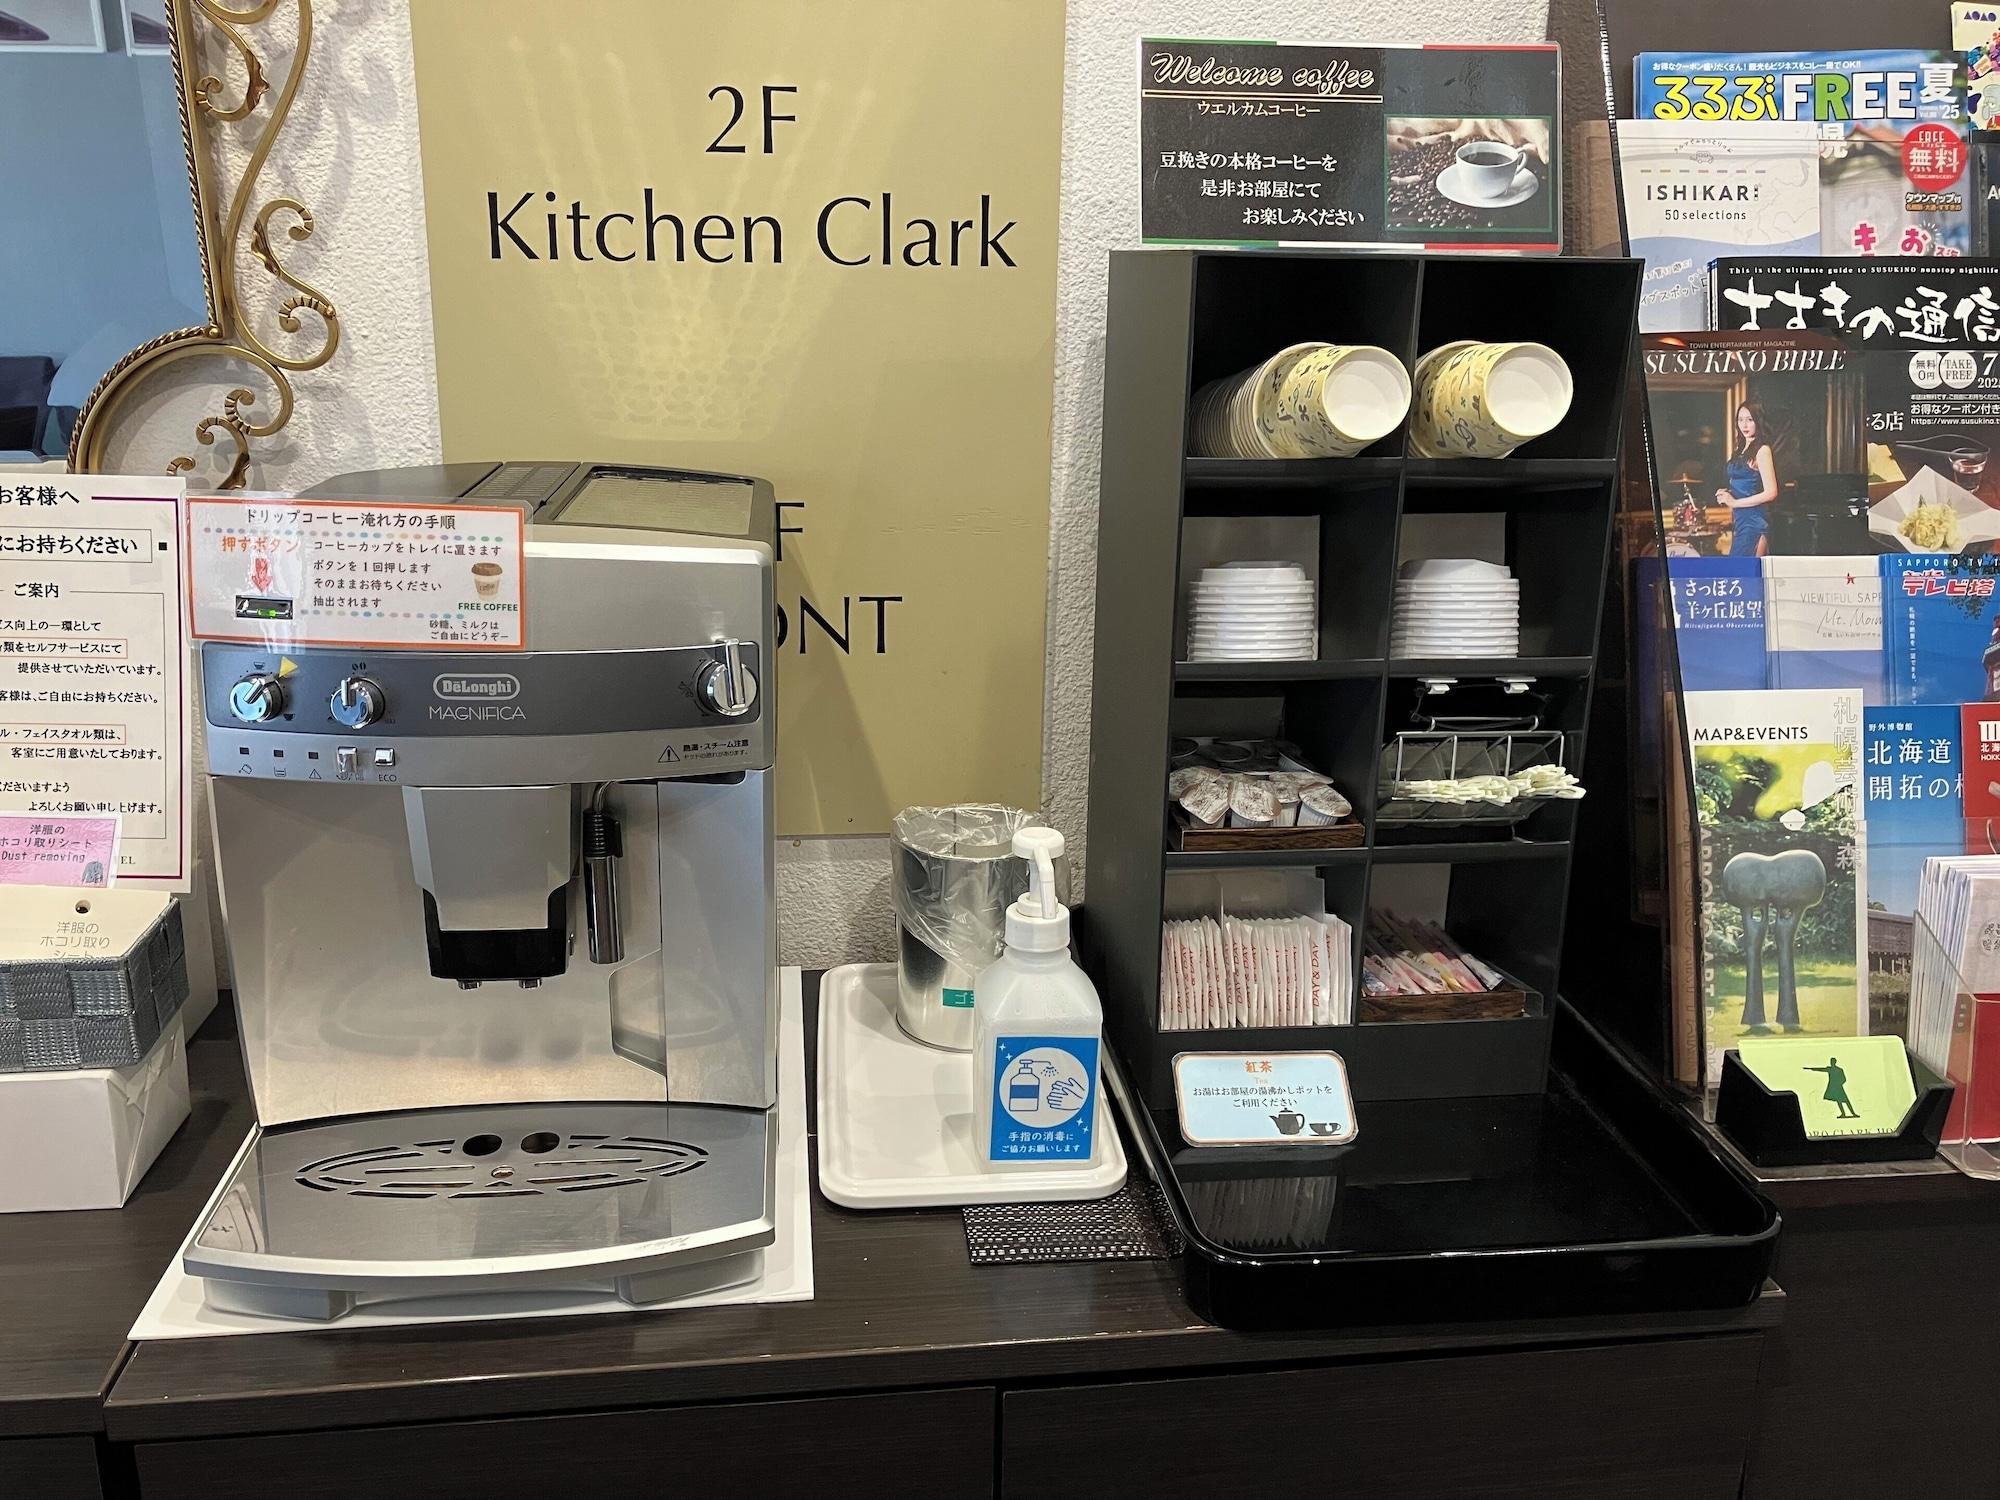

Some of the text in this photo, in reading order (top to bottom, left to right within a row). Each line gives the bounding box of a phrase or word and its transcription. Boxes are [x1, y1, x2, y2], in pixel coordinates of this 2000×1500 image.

[1151, 53, 1374, 95] Welcome coffee
[1919, 63, 1959, 103] 夏
[1197, 101, 1321, 117] ウエルカムコーヒー
[706, 86, 797, 153] 2F
[1160, 150, 1337, 172] 豆挽きの本格コーヒーを
[1909, 148, 1960, 173] 無料
[1200, 178, 1322, 199] 是非お部屋にて
[1242, 206, 1365, 227] お楽しみください
[1665, 209, 1747, 221] 50 selections
[487, 188, 1018, 267] Kitchen Clark
[1728, 266, 1999, 275] This is the ultimate guide to SUSUKINO nonstop nightlife
[1644, 349, 1847, 375] SUSUKINO BIBLE
[1945, 360, 1973, 370] TAKE
[1983, 353, 1999, 376] 7
[1945, 370, 1973, 380] FREE
[247, 508, 456, 530] ドリップコーヒー淹れ方の手順
[221, 536, 300, 553] 押すボタン
[313, 540, 502, 557] コーヒーカップをトレイに置きます
[1897, 558, 1959, 566] SAPPORO
[1969, 558, 1984, 566] TV
[14, 583, 60, 599] ご案内
[313, 578, 442, 592] そのままお待ちください
[1685, 579, 1743, 597] さっぽろ
[1903, 578, 1995, 597] テレビ塔
[313, 596, 382, 608] 抽出されます
[1801, 592, 1852, 604] VIEWTIFUL
[458, 602, 519, 612] FREE COFFEE
[429, 619, 499, 630] 砂糖、ミルクは
[777, 596, 903, 655] NT
[17, 662, 162, 676] 提供させていただいています。
[429, 705, 526, 721] MAGNIFICA
[1693, 727, 1808, 741] MAP&EVENTS
[1868, 723, 1913, 732] 野外博物館
[11, 747, 163, 761] 客室にご用意いたしております。
[1867, 738, 1952, 765] 北海道
[378, 774, 397, 782] ECO
[1833, 696, 1862, 870] 札幌芸術の森
[28, 801, 162, 814] よろしくお願い申し上げます。
[30, 824, 65, 835] 洋服の
[0, 837, 92, 848] ホコリ取りシート
[1, 851, 86, 863] Dust removing
[56, 921, 100, 935] 洋服の
[40, 936, 111, 949] ホコリ取り
[1312, 943, 1320, 967] DAY
[1312, 982, 1320, 1007] DAY
[1245, 1061, 1273, 1073] 紅茶
[1233, 1098, 1298, 1108] ご利用ください
[1008, 1131, 1074, 1142] 手指の消毒に
[1001, 1144, 1081, 1153] ご協力お願いします
